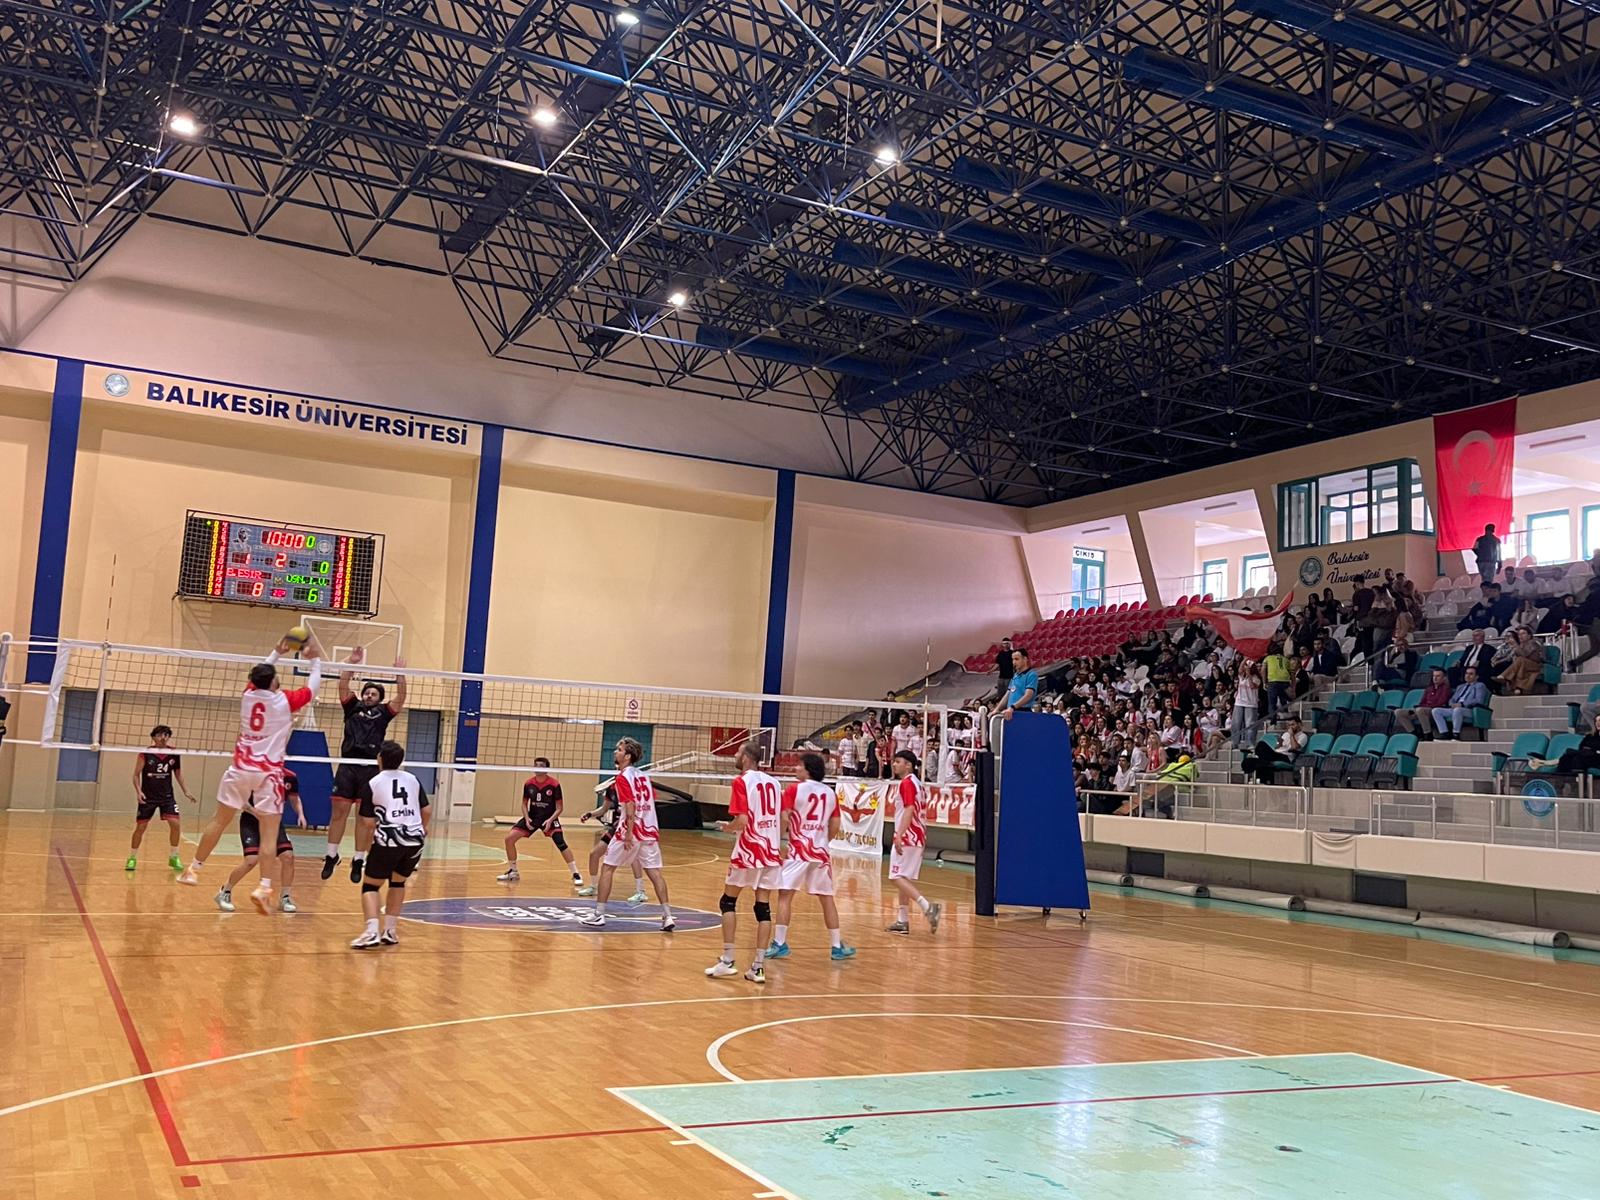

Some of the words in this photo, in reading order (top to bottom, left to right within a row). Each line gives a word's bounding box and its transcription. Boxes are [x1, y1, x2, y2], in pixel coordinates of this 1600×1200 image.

[147, 382, 290, 419] BALIKESİR
[295, 400, 468, 445] ÜNİVERSİTESİ
[275, 552, 287, 568] 2
[251, 582, 264, 597] 8
[307, 588, 318, 603] 6
[250, 702, 266, 732] 6
[156, 763, 169, 773] 24
[392, 779, 408, 806] 4
[634, 776, 651, 802] 95
[756, 782, 777, 816] 10
[392, 807, 415, 818] EMİN
[807, 793, 827, 821] 21
